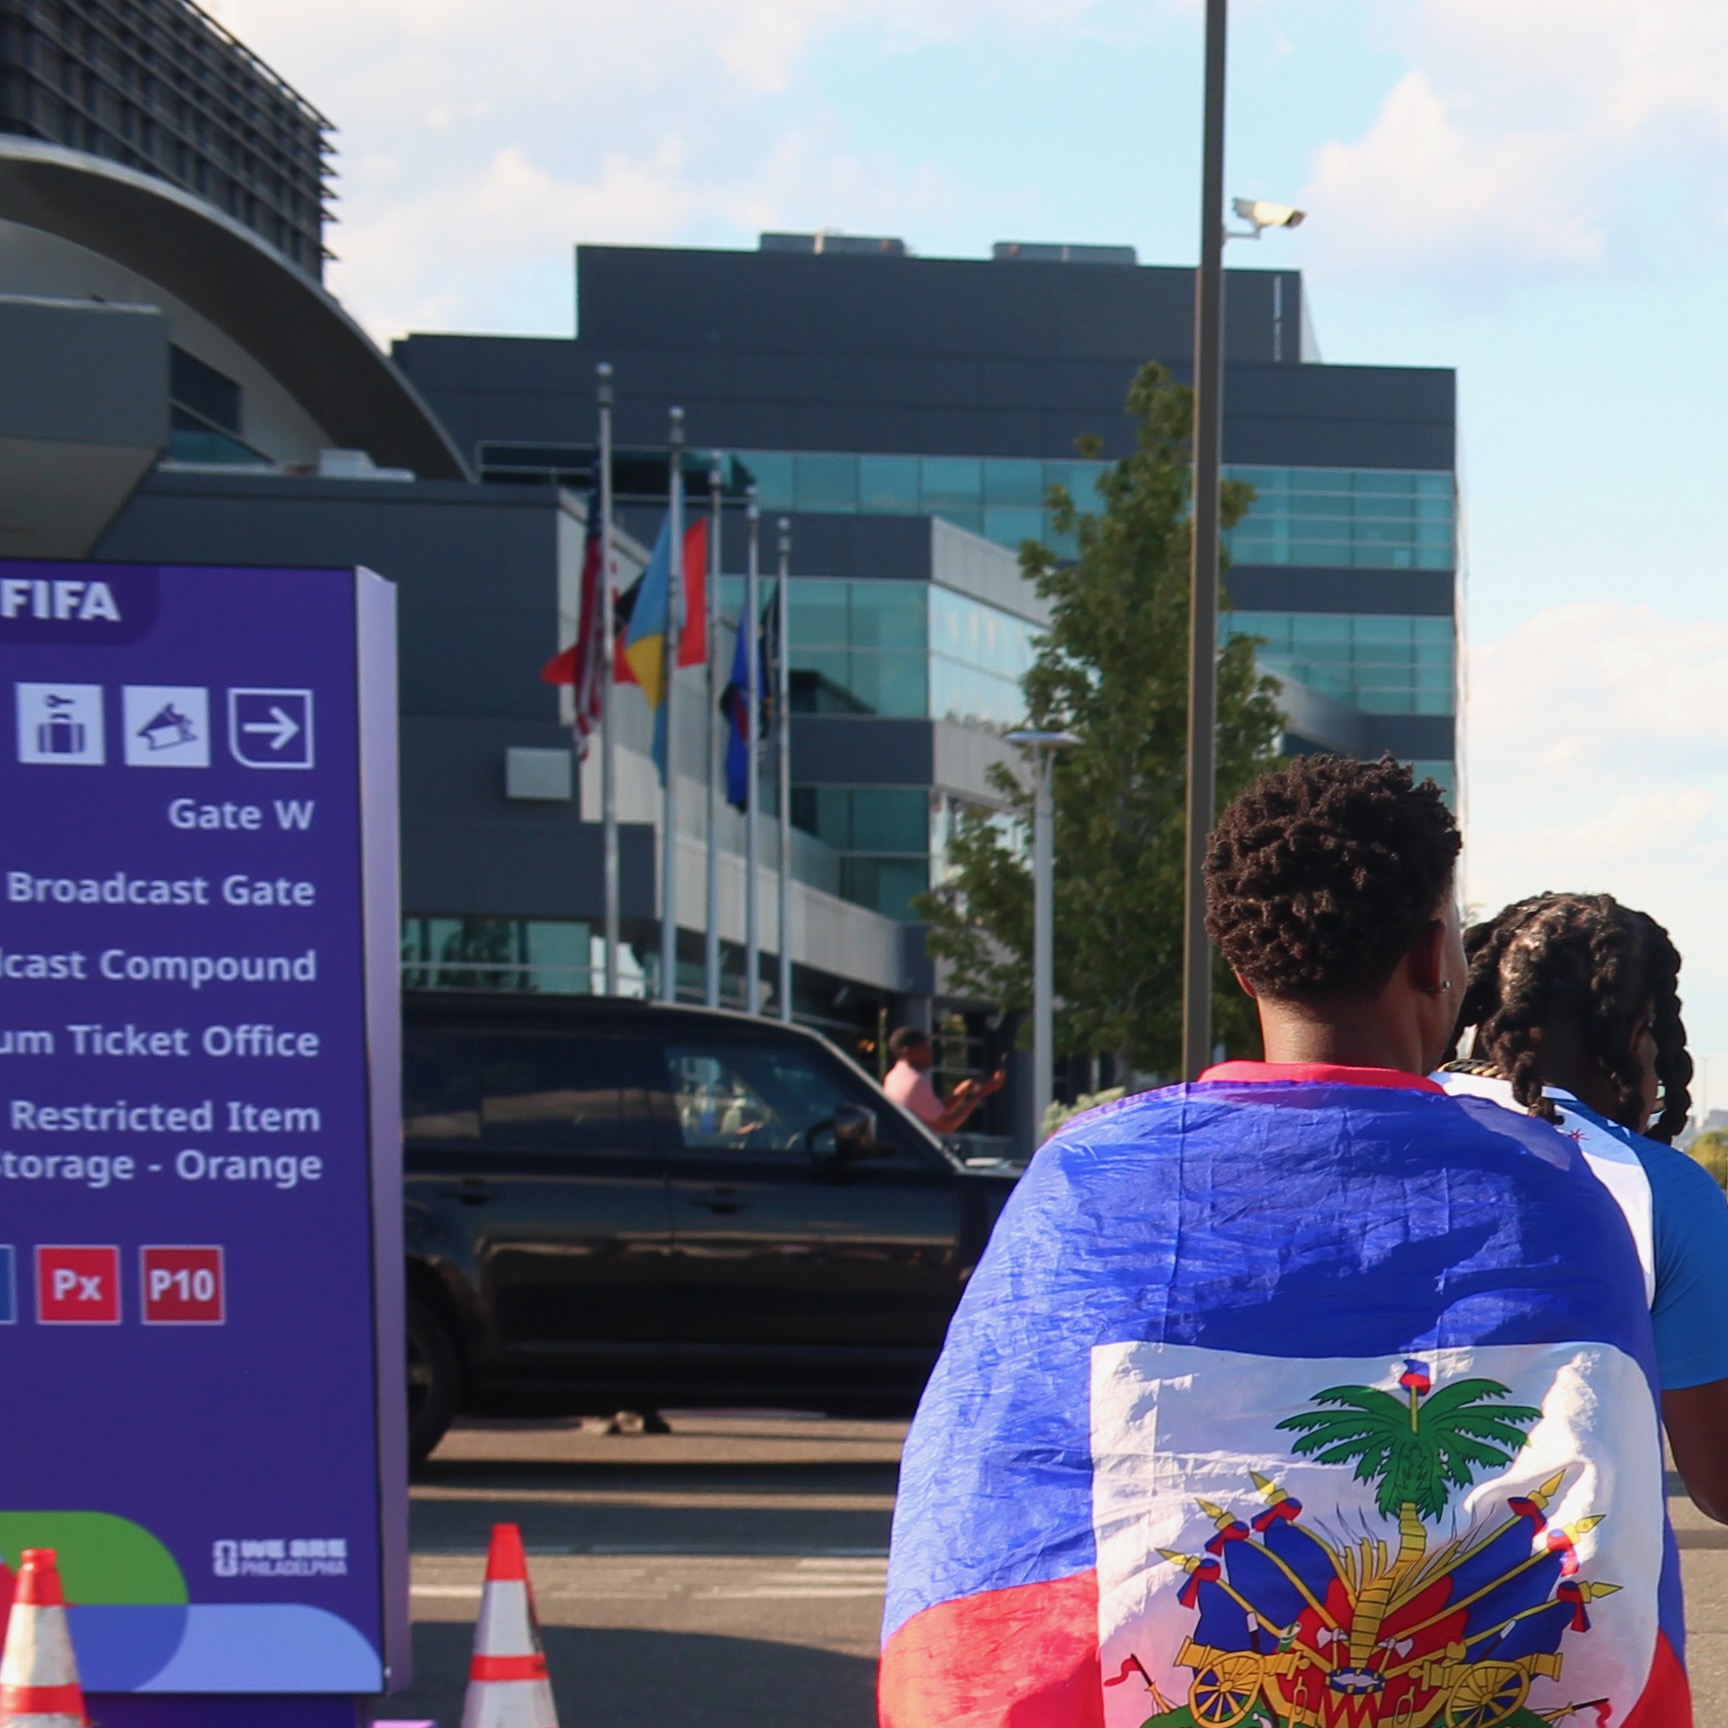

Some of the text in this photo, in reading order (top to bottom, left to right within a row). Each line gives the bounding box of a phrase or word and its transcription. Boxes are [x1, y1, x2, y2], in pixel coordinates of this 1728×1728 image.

[1, 578, 121, 622] FIFA
[168, 798, 315, 830] Gate W
[7, 871, 316, 906] Broadcast Gate
[100, 948, 317, 990] Compound
[67, 1024, 190, 1056] Ticket
[203, 1024, 320, 1057] Office
[11, 1100, 321, 1132] Restricted Item
[0, 1150, 135, 1189] torage
[176, 1149, 323, 1189] Orange
[52, 1268, 103, 1302] Px
[149, 1268, 215, 1302] P10
[240, 1559, 348, 1576] PHILADELPHIA
